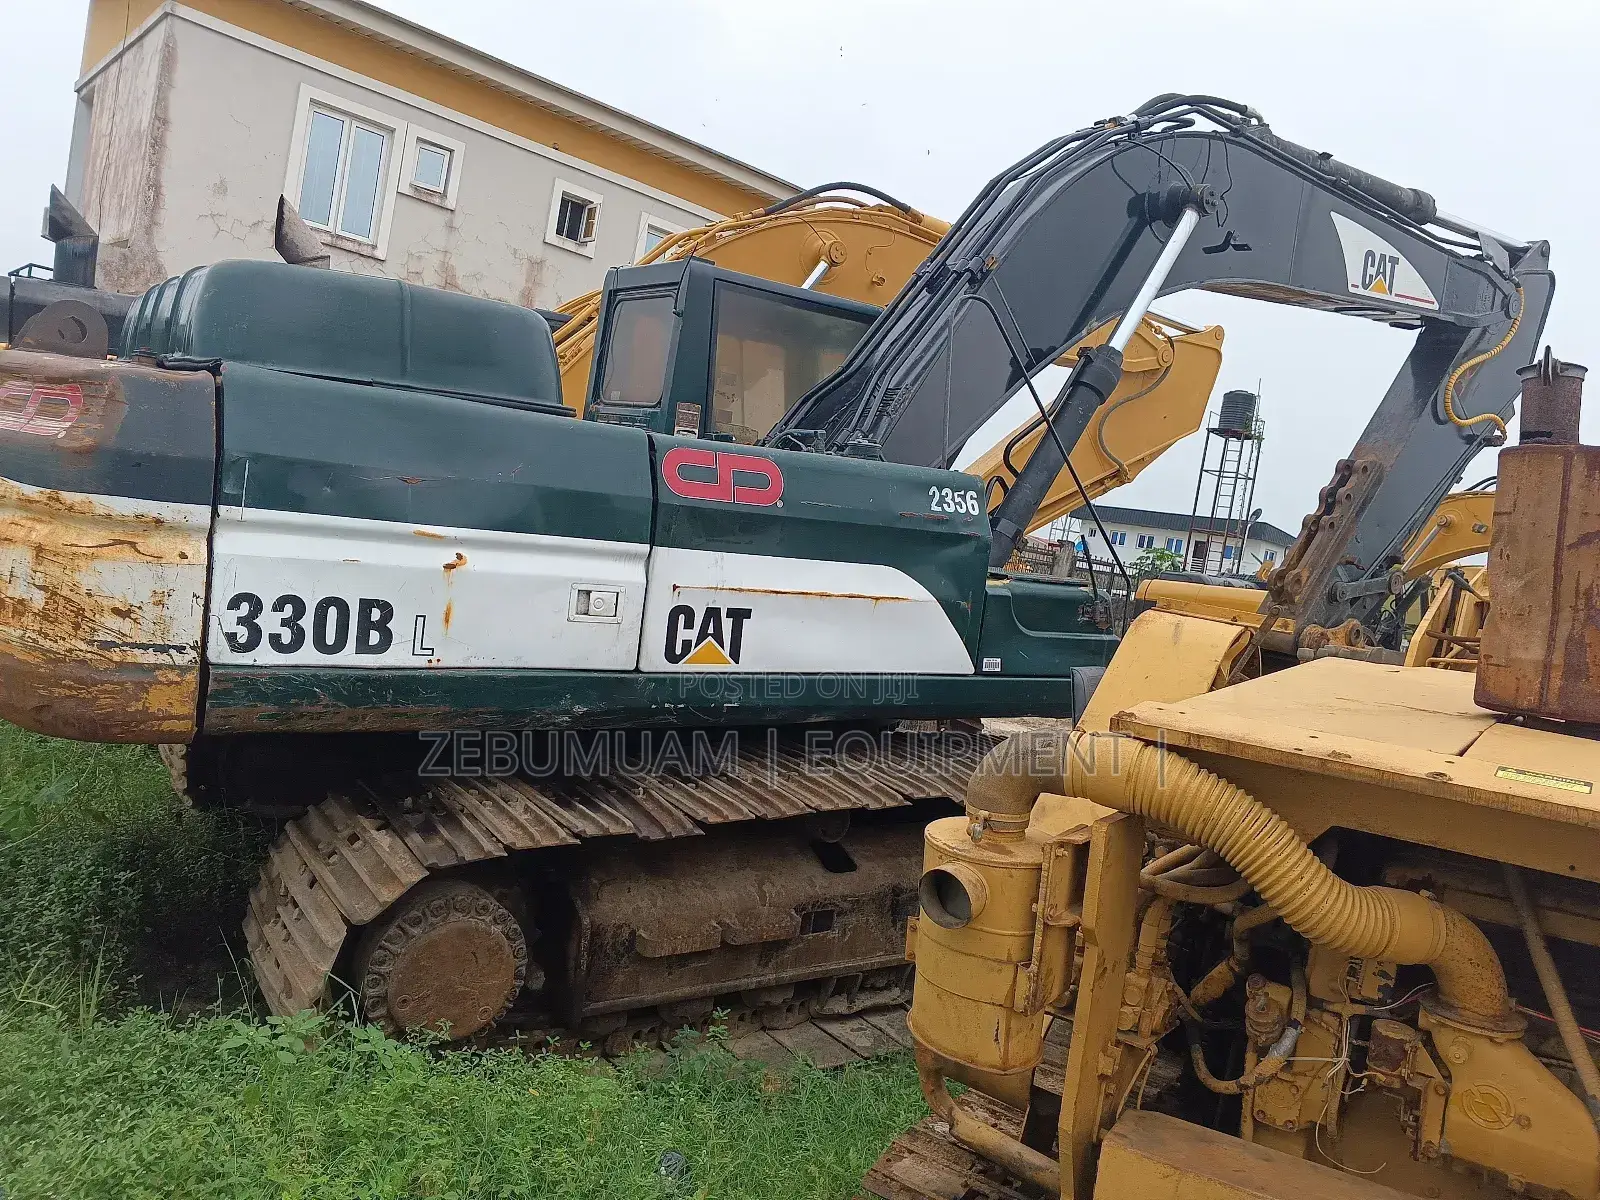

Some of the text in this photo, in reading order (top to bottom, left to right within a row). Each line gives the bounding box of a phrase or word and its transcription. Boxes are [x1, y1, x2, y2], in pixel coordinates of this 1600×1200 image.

[1361, 249, 1399, 296] CAT
[928, 486, 980, 516] 2356
[224, 592, 435, 656] 330B L
[664, 604, 752, 665] CAT
